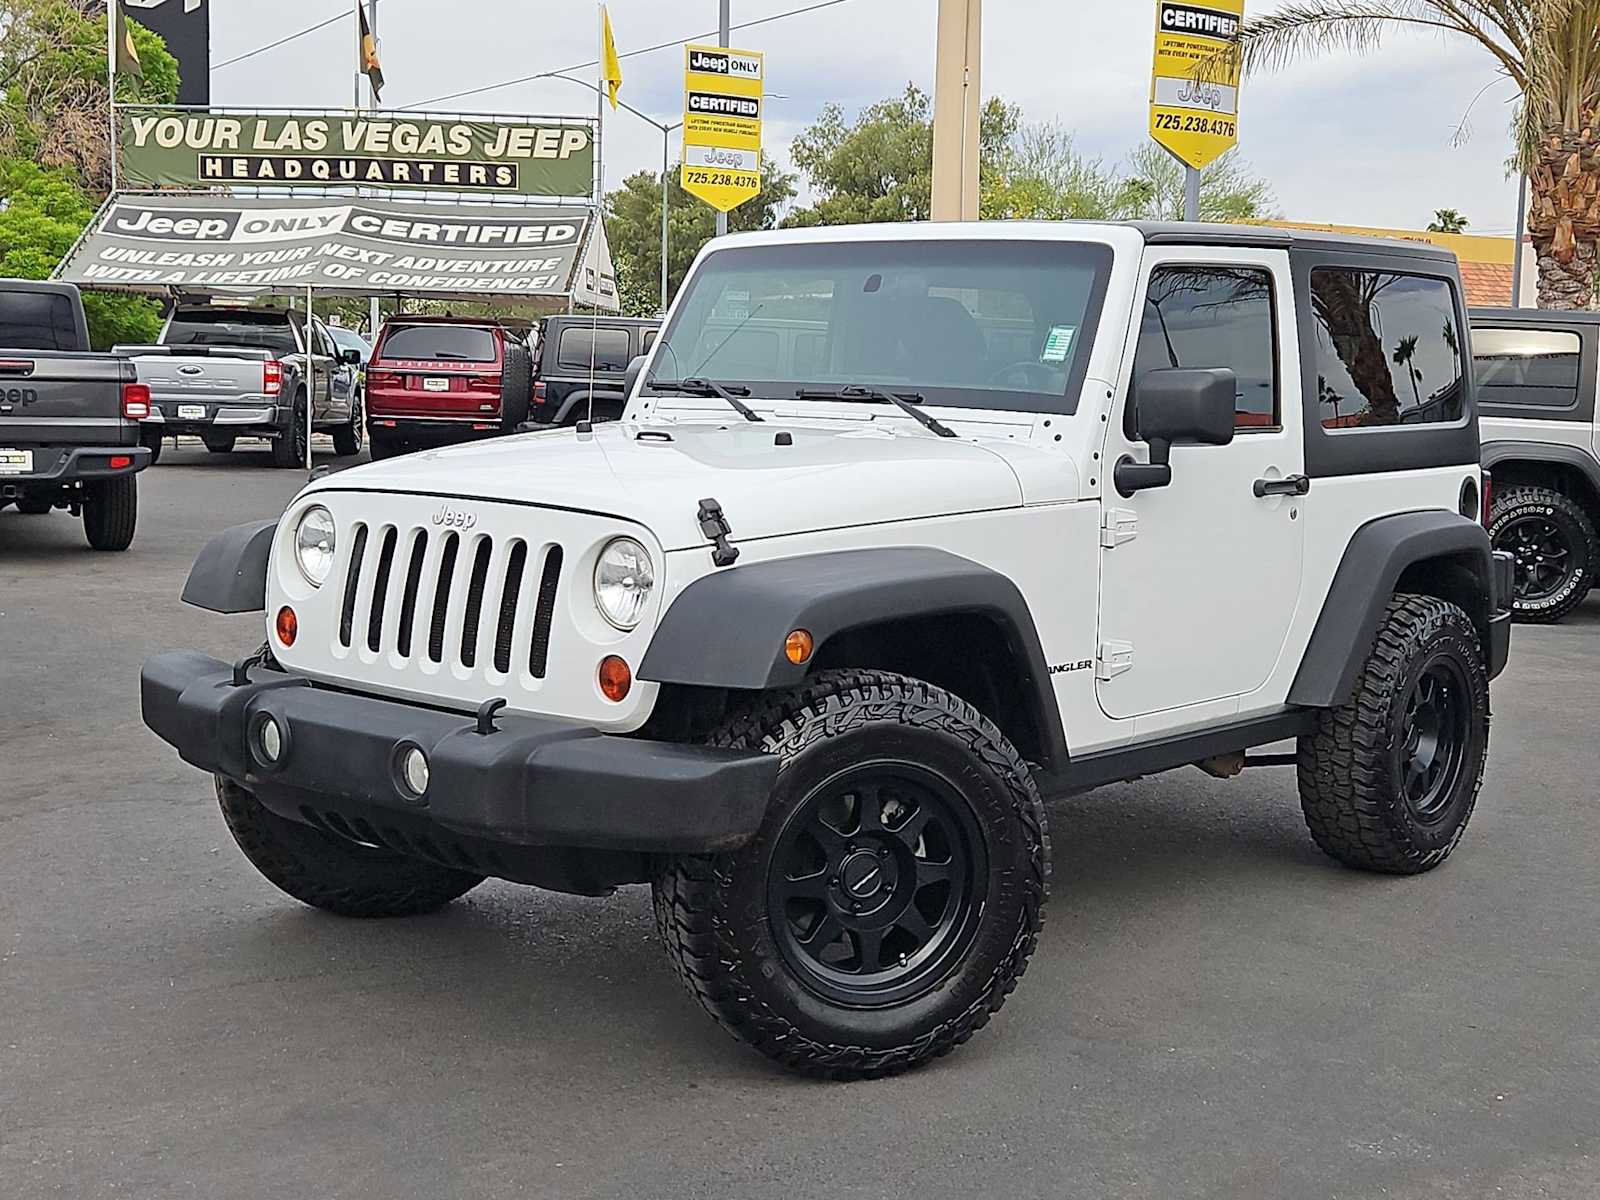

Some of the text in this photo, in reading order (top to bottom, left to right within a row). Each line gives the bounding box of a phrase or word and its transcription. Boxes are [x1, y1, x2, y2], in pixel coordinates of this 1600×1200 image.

[1163, 9, 1238, 35] CERTIFIED
[692, 53, 759, 73] Jeep ONLY
[690, 96, 758, 115] CERTIFIED
[1177, 81, 1221, 109] Jeep
[131, 117, 588, 159] YOUR LAS VEGAS JEEP
[1155, 114, 1235, 137] 725.238.4376
[205, 158, 513, 185] HEADQUARTERS
[704, 148, 743, 168] Jeep
[687, 172, 757, 188] 725.238.4376
[116, 211, 576, 244] Jeep ONLY CERTIFIED
[99, 242, 563, 273] UNLEASH YOUR NEXT ADVENTURE
[82, 261, 560, 290] WITH A LIFETIME OF CONFIDENCE!
[432, 504, 478, 532] Jeep
